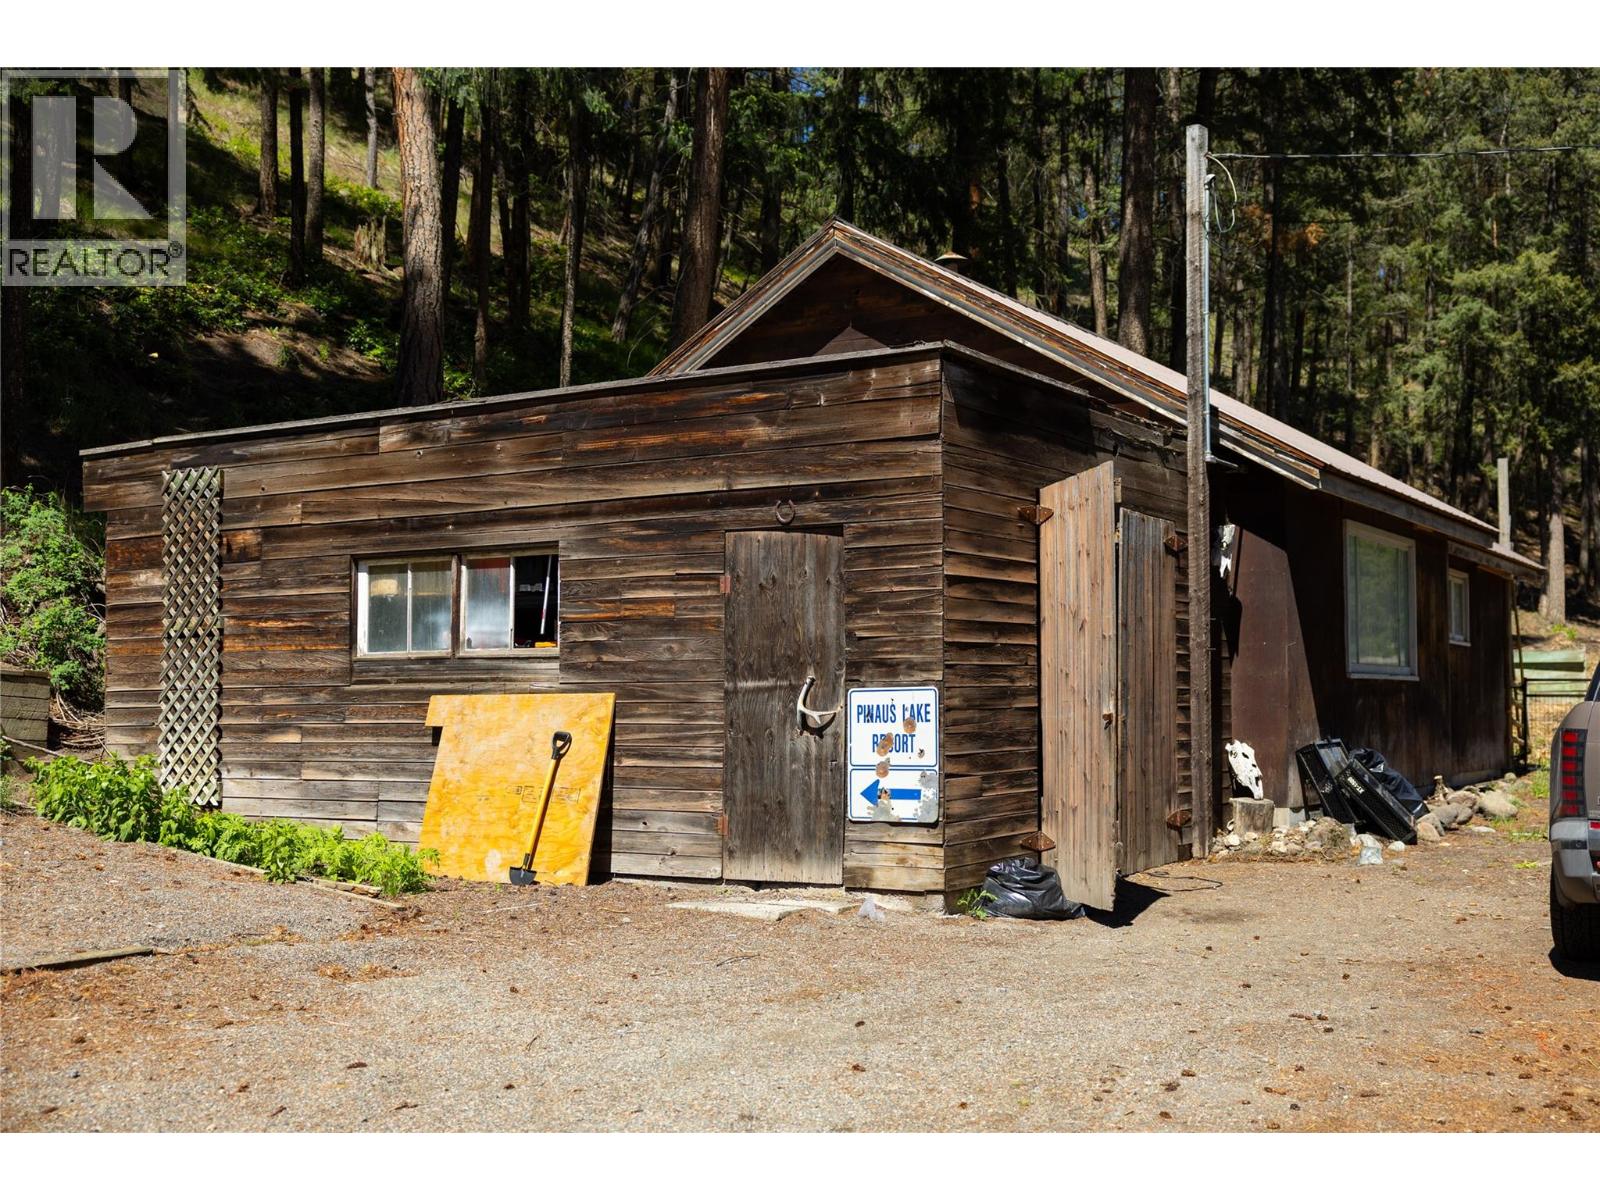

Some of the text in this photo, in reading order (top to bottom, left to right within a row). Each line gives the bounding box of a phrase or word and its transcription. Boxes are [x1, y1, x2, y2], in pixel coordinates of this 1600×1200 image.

[856, 703, 931, 724] PINAUS LAKE
[872, 733, 916, 753] RORT
